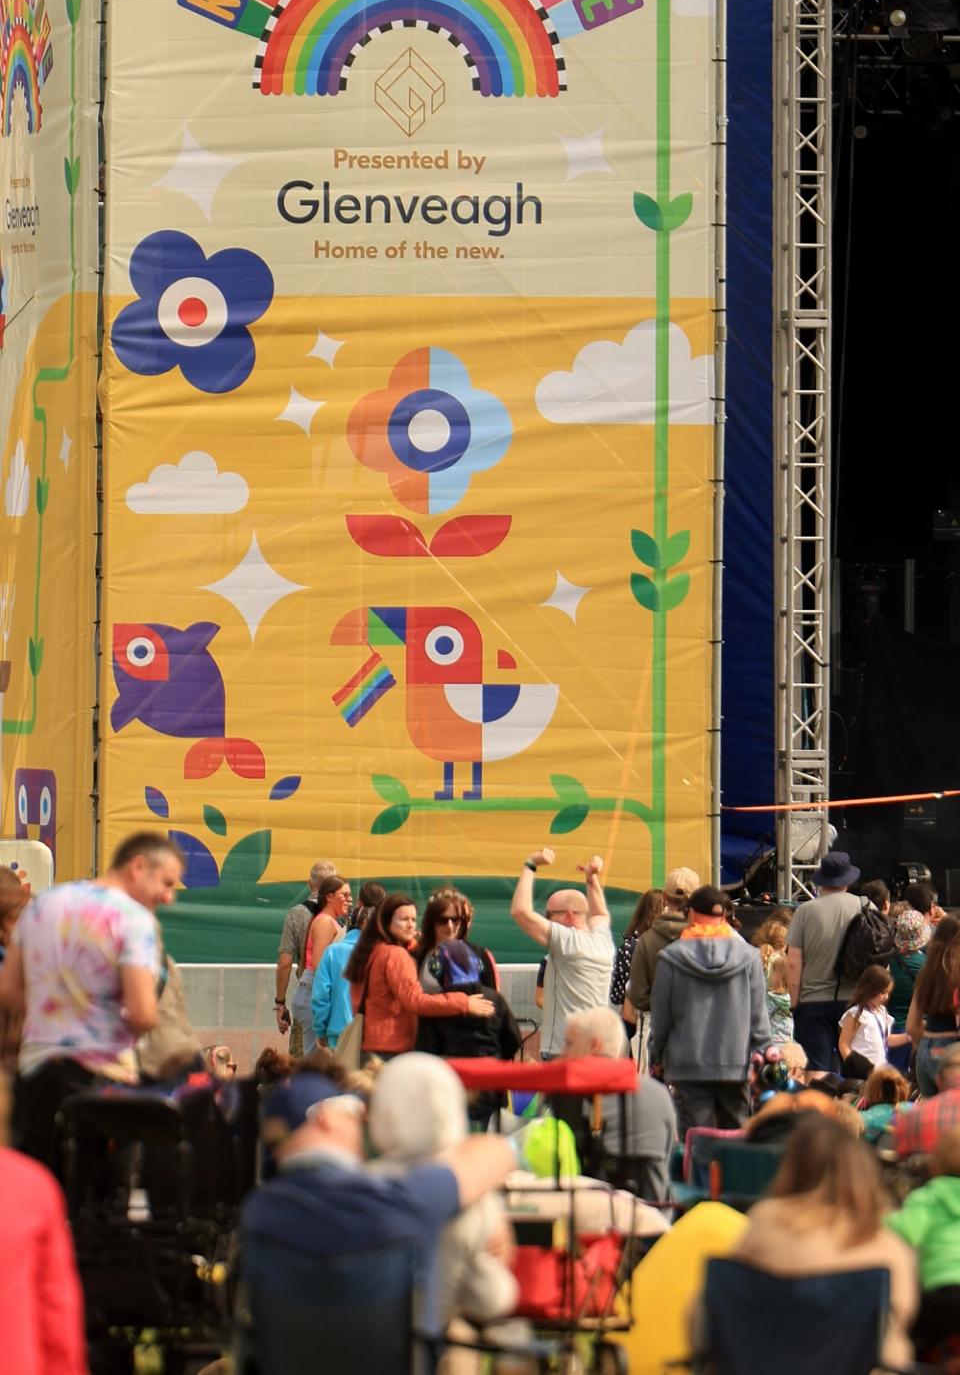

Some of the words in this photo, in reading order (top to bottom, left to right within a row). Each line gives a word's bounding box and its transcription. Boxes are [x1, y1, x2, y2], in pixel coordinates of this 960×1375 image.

[333, 149, 449, 170] Presented
[457, 149, 487, 175] by
[276, 179, 543, 237] Glenveagh
[313, 240, 378, 259] Home
[384, 240, 407, 259] of
[413, 241, 449, 259] the
[455, 244, 505, 259] new.
